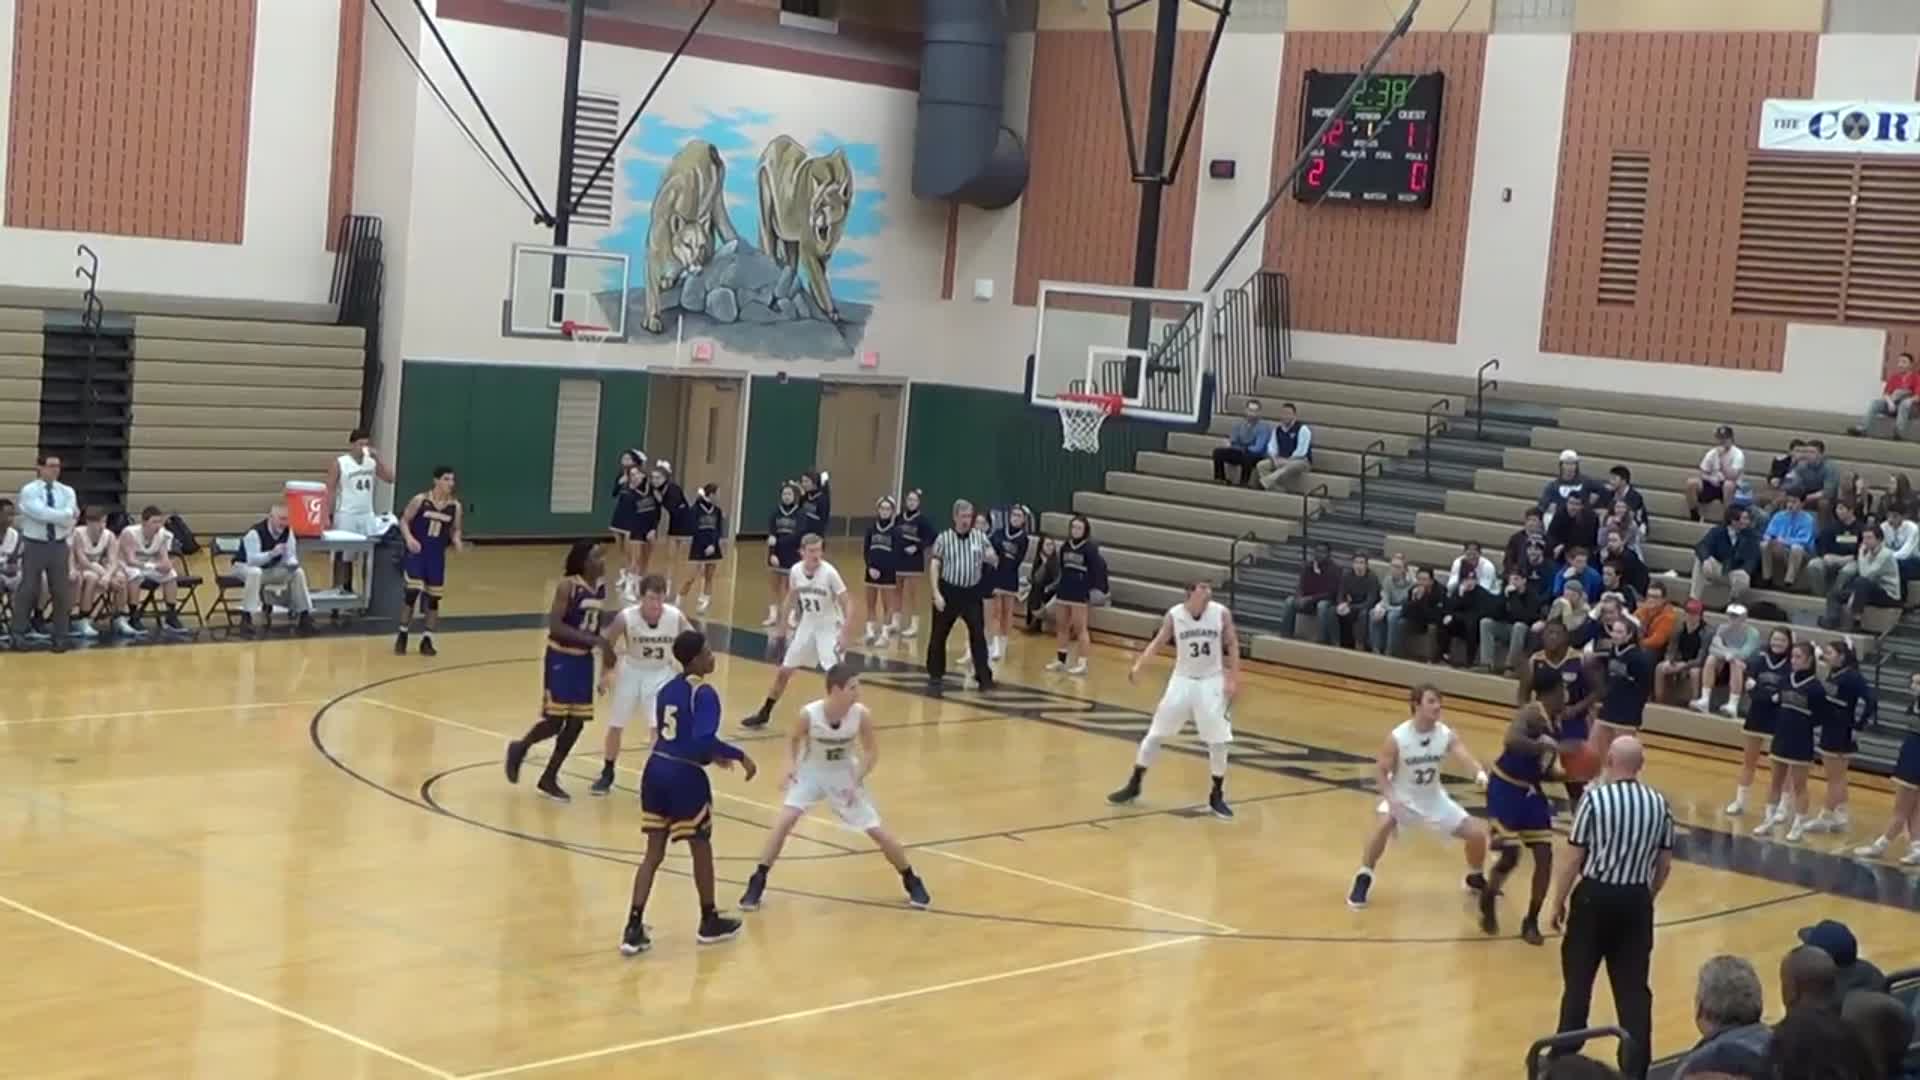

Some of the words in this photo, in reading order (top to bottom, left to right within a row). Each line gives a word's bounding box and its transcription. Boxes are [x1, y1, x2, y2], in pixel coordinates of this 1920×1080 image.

[1774, 118, 1800, 129] THE
[1808, 110, 1920, 142] COR
[1308, 158, 1324, 186] 2
[355, 478, 371, 492] 44
[642, 646, 664, 660] 23
[1188, 641, 1210, 658] 34
[661, 704, 679, 741] 5
